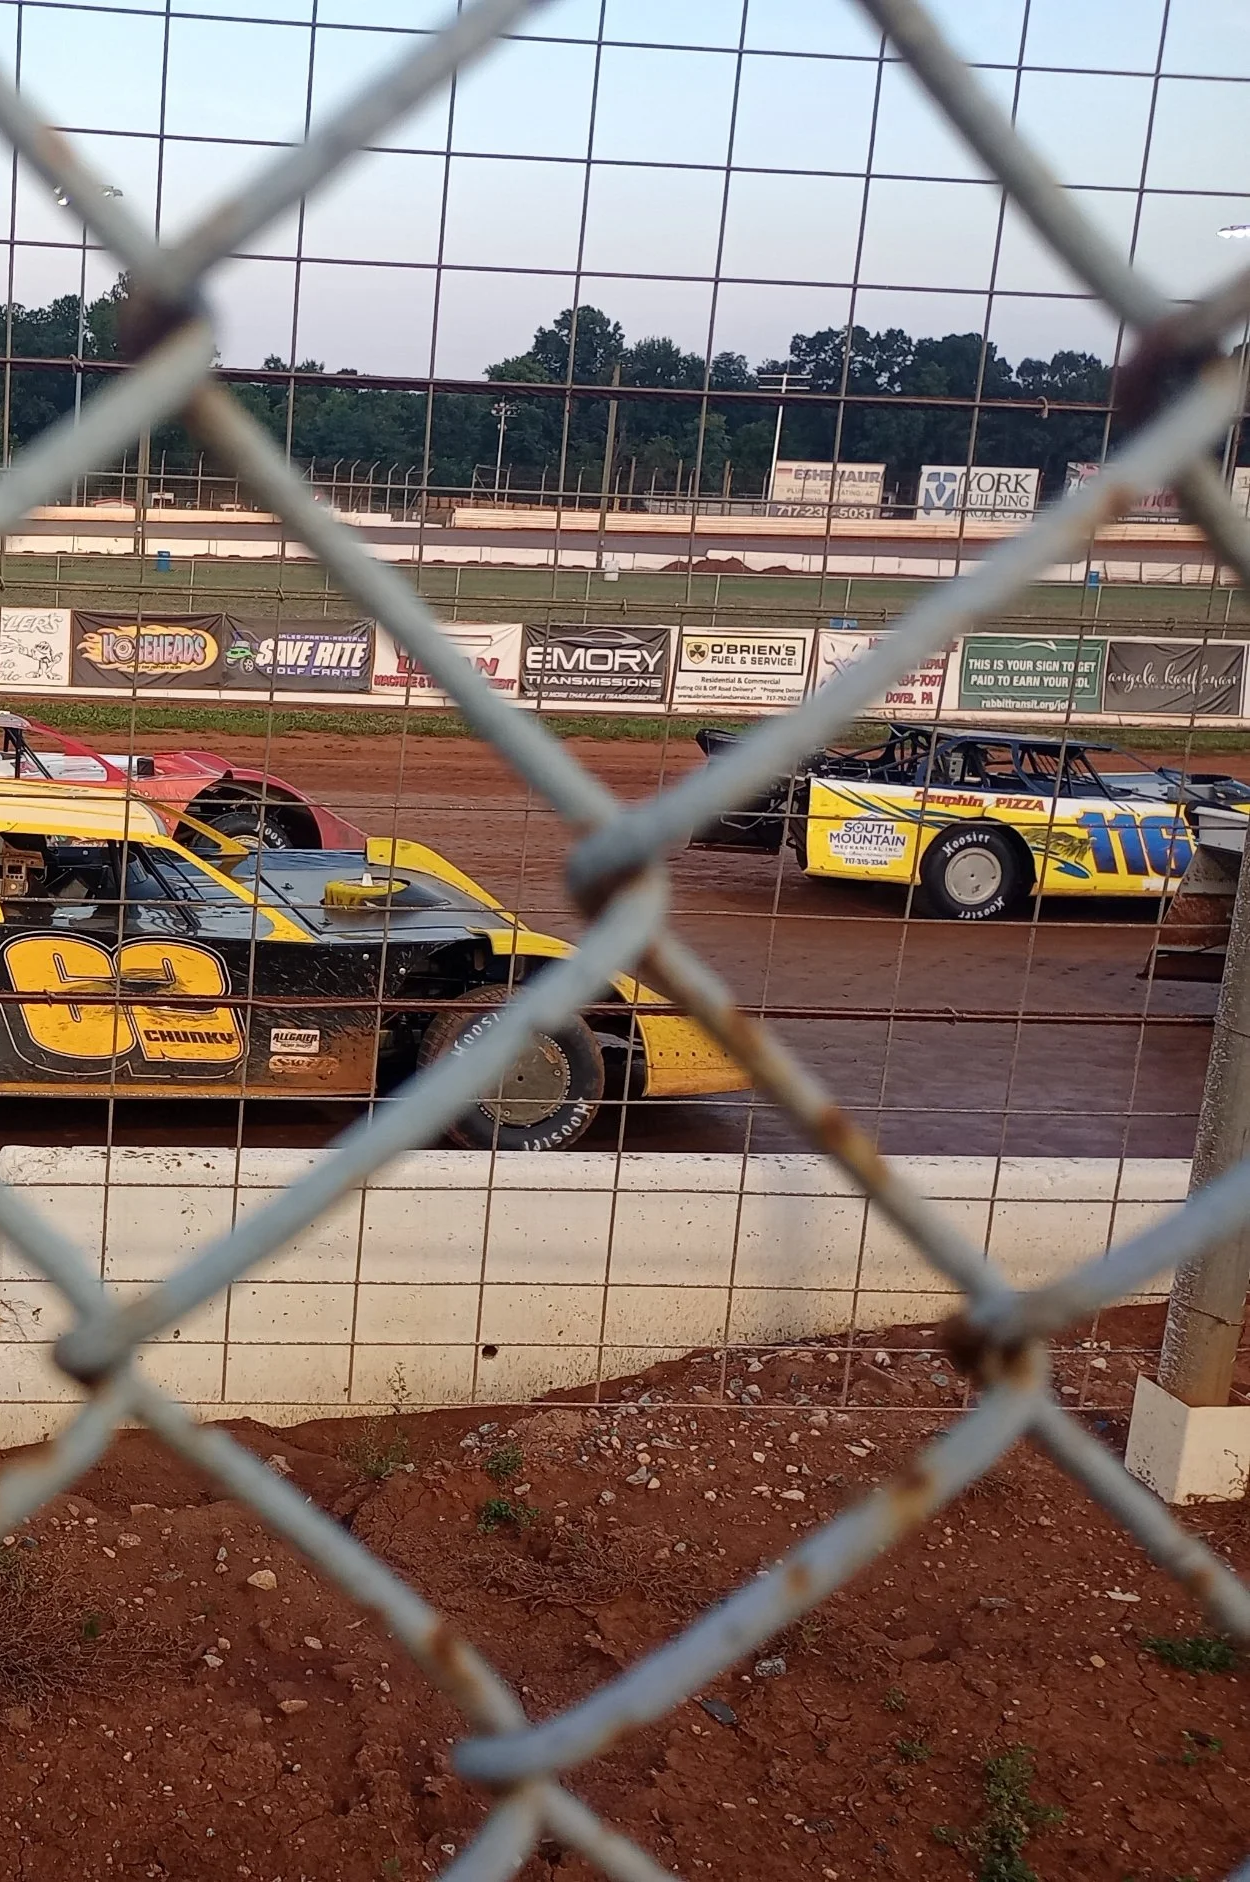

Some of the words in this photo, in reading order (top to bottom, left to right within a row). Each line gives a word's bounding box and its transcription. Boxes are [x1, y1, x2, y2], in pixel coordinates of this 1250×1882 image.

[958, 508, 1029, 519] RODUCTS
[313, 641, 367, 667] RITE
[711, 642, 796, 656] O'BRIEN'S
[526, 647, 663, 672] EMORY
[711, 656, 736, 664] FUEL
[739, 657, 747, 665] &
[751, 657, 793, 666] SERVICE
[969, 659, 990, 670] THIS
[993, 660, 1004, 670] IS
[1007, 660, 1033, 671] YOUR
[1036, 661, 1059, 672] SIGN
[1062, 662, 1074, 672] TO
[1078, 662, 1096, 672] GET
[311, 668, 360, 676] CARTS
[525, 675, 662, 687] TRANSMISSIONS
[970, 675, 994, 686] PAID
[998, 676, 1010, 686] TO
[1012, 676, 1040, 687] EARN
[1043, 677, 1068, 688] YOUR
[921, 692, 933, 704] PA
[995, 797, 1045, 812] PIZZA
[844, 822, 894, 835] SOUTH
[830, 832, 906, 846] MOUNTAIN
[942, 831, 990, 858] Hoosier
[1076, 811, 1193, 878] 116
[957, 896, 1005, 919] Hoosier
[143, 1029, 237, 1044] CHUNKY
